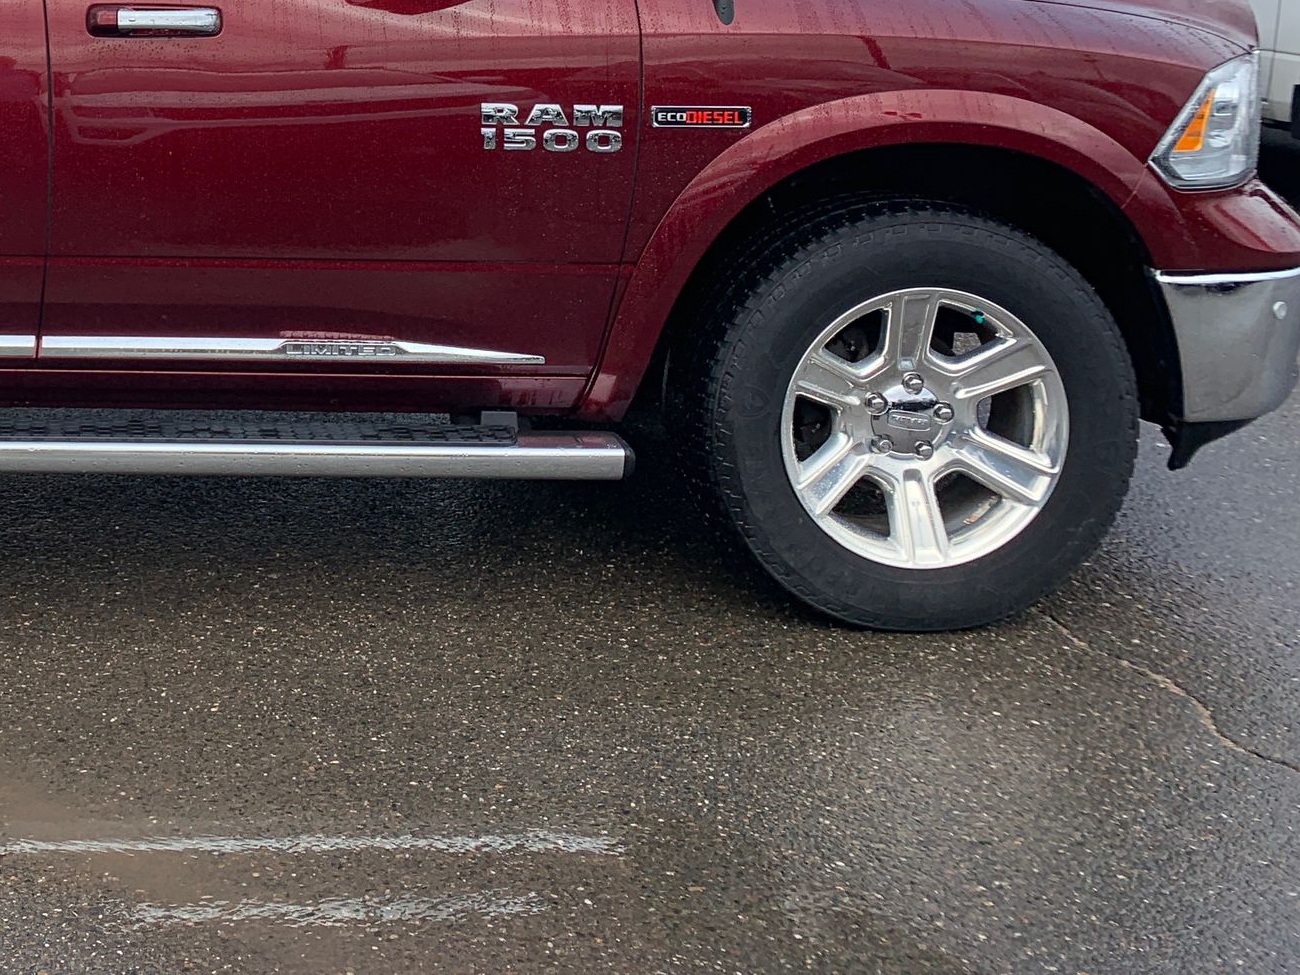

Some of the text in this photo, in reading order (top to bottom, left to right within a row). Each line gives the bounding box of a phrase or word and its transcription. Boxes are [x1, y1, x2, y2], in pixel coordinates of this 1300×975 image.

[480, 102, 624, 127] RAM
[657, 110, 744, 125] ECODIESEL
[481, 127, 623, 153] 1500
[286, 344, 397, 356] LIMITED
